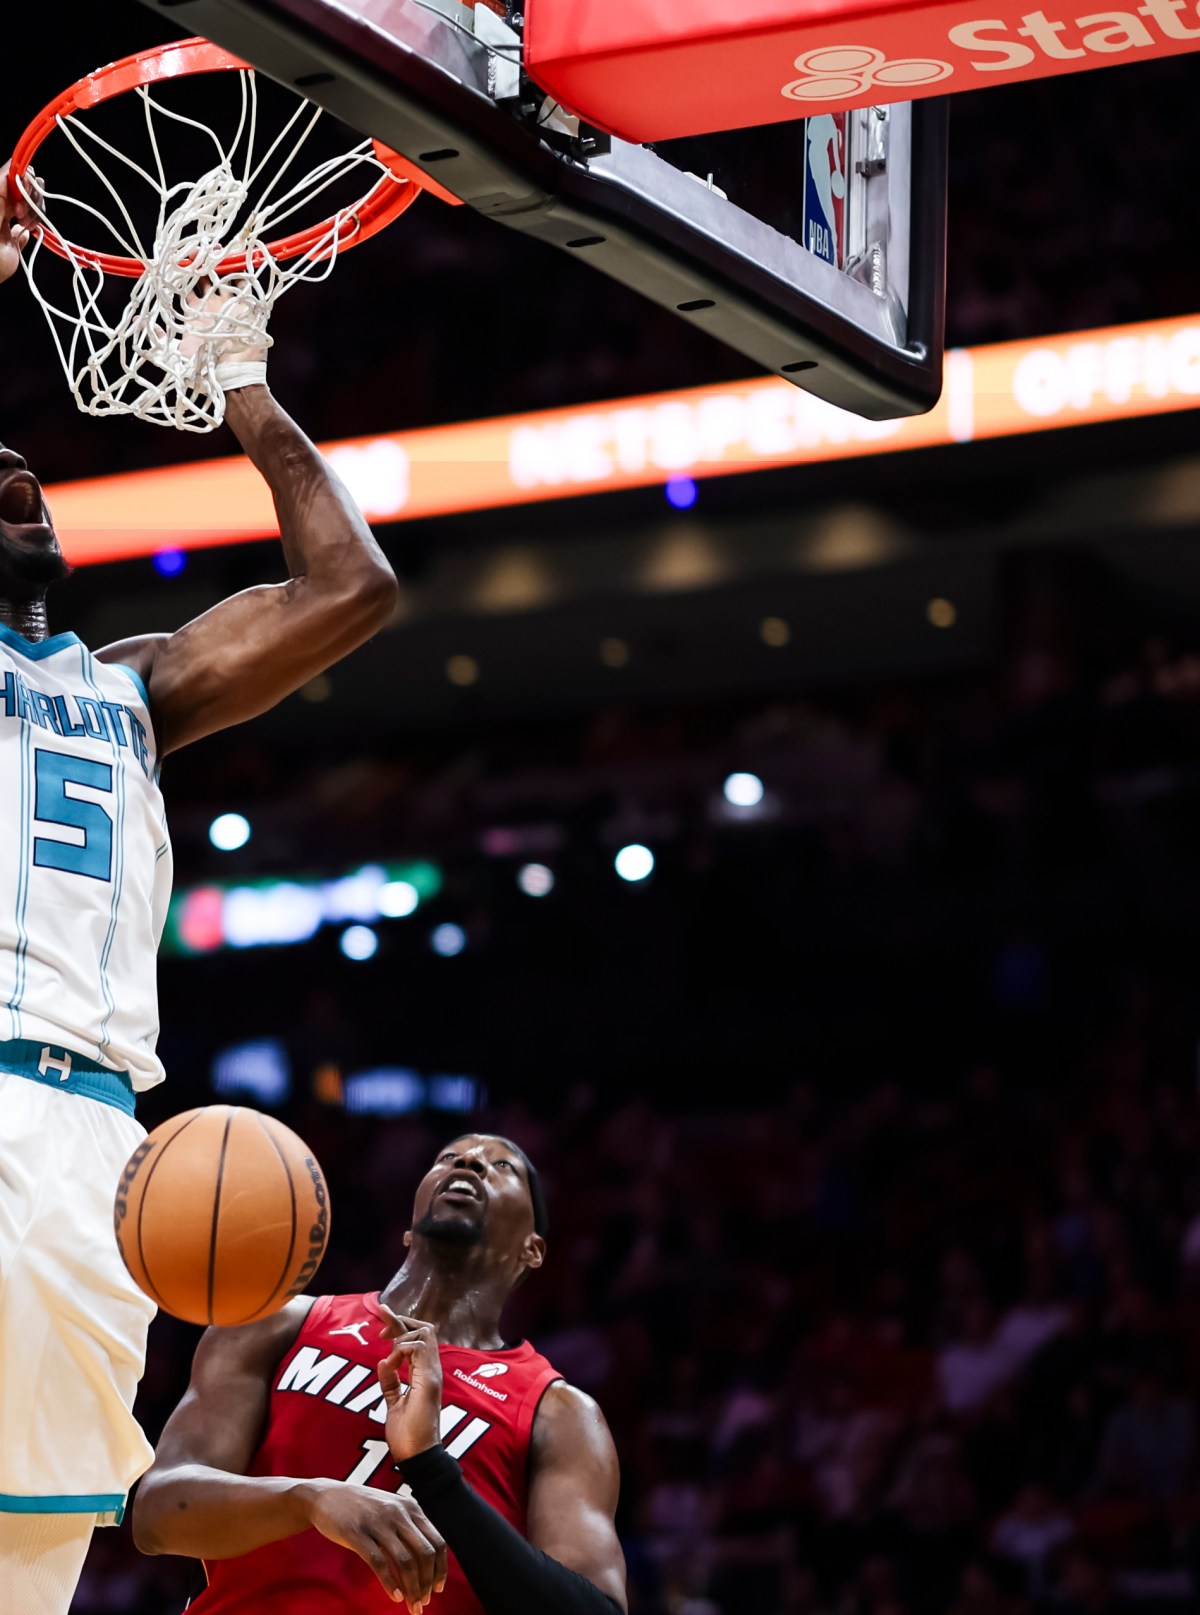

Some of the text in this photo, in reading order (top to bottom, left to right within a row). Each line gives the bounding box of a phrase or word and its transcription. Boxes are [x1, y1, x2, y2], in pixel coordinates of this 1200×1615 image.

[948, 0, 1200, 72] Stat
[809, 218, 830, 260] NBA
[33, 748, 113, 883] 5
[453, 1368, 508, 1403] Robinhood
